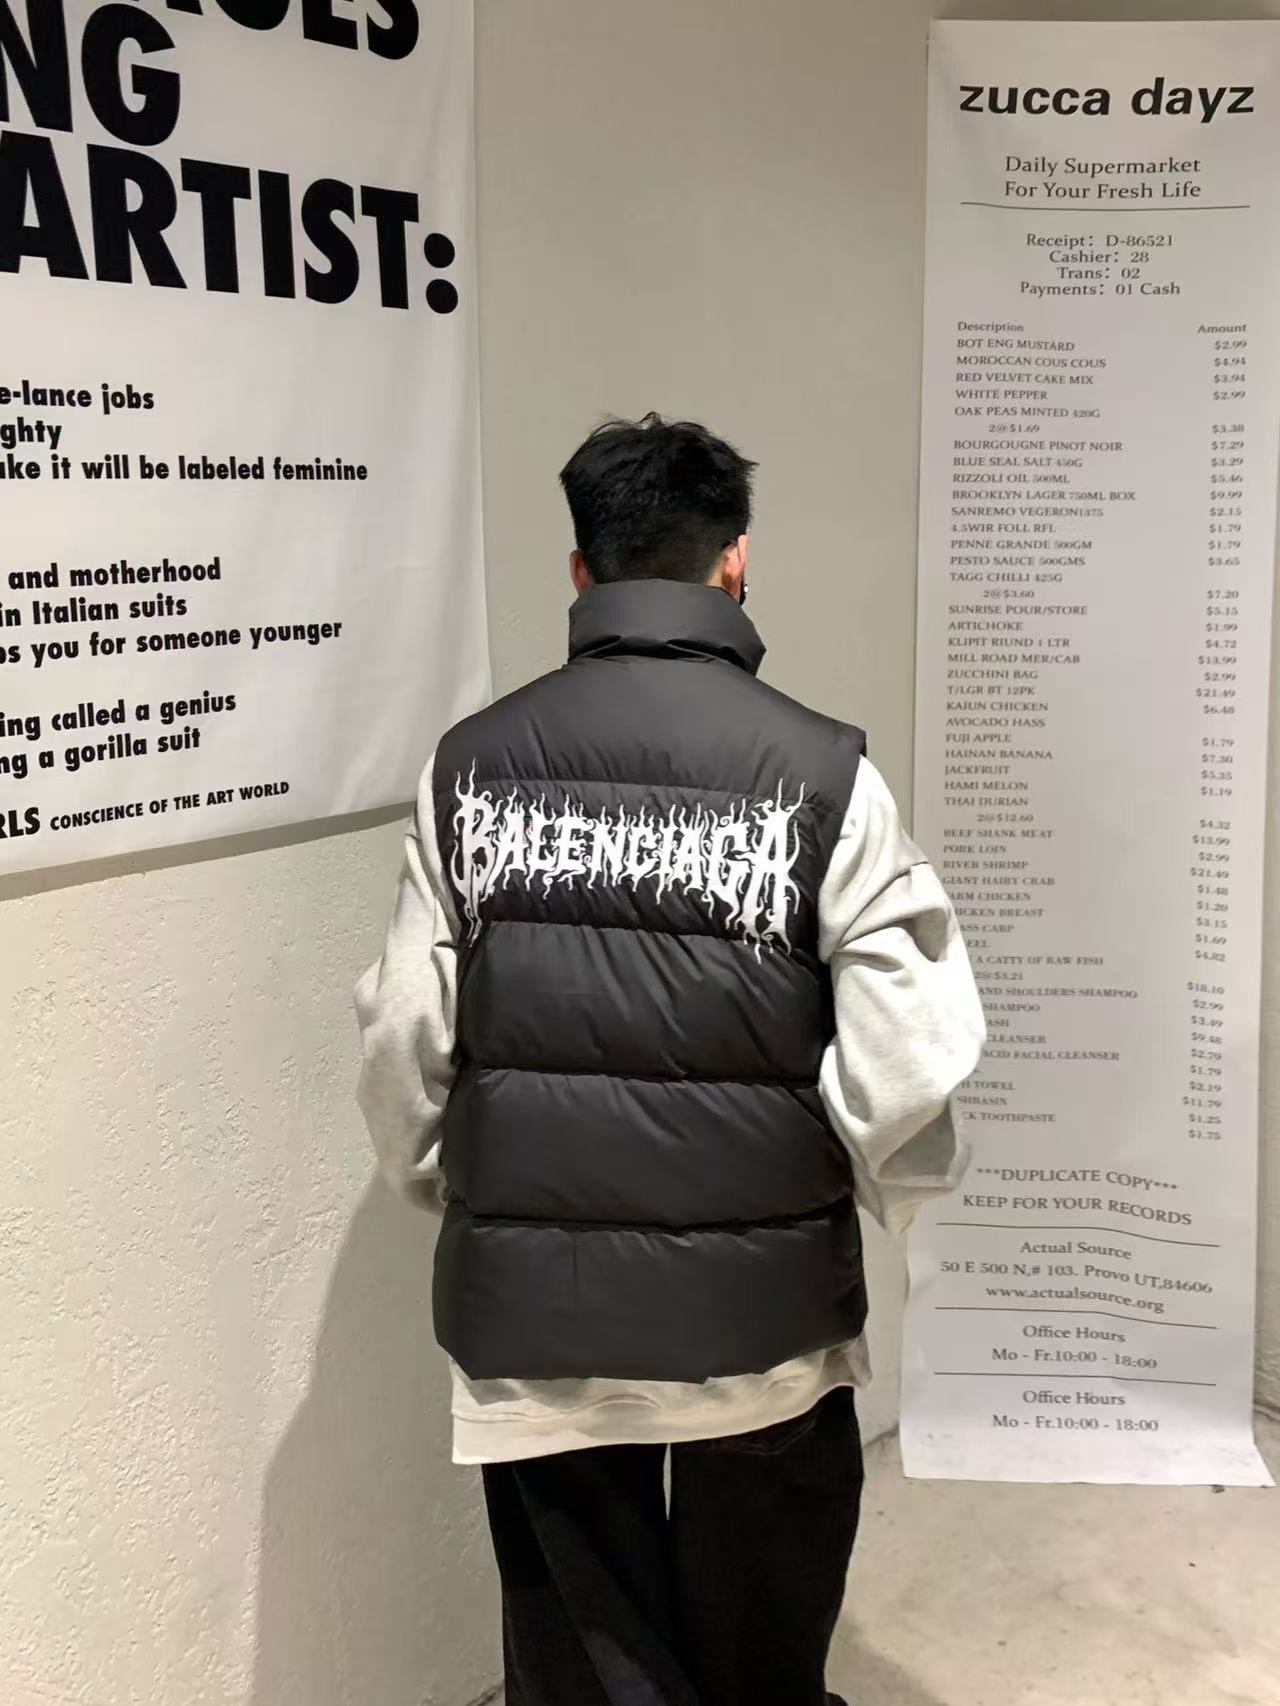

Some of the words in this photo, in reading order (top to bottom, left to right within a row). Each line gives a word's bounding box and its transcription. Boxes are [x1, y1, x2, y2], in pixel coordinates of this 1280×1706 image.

[960, 85, 1111, 116] zucca
[1132, 77, 1255, 123] dayz
[1005, 156, 1057, 177] Daily
[1065, 157, 1201, 178] Supermarket
[1005, 181, 1037, 198] For
[1044, 182, 1090, 199] Your
[1097, 183, 1152, 199] Fresh
[1162, 182, 1201, 198] Life
[0, 130, 458, 314] ARTIST:
[1106, 235, 1173, 247] D-86521
[1130, 252, 1149, 263] 28
[1121, 268, 1140, 279] 02
[1116, 284, 1132, 295] 01
[1140, 283, 1180, 295] Cash
[958, 322, 1024, 333] Description
[1197, 325, 1246, 333] Amount
[957, 339, 983, 348] BOT
[988, 339, 1013, 349] ENG
[1017, 340, 1075, 351] MUSTARD
[957, 356, 1032, 366] MOROCCAN
[1035, 357, 1067, 367] COUS
[1071, 358, 1106, 368] COUS
[956, 373, 982, 382] RED
[986, 373, 1031, 383] VELVET
[1035, 374, 1066, 384] CAKE
[1070, 375, 1094, 384] MIX
[0, 380, 92, 406] e-lance
[102, 383, 154, 414] jobs
[956, 390, 999, 399] WHITE
[1004, 390, 1047, 399] PEPPER
[955, 407, 982, 416] OAK
[987, 407, 1017, 416] PEAS
[1021, 408, 1068, 417] MINTED
[0, 418, 61, 449] ghty
[1049, 442, 1086, 450] PINOT
[1089, 442, 1122, 451] NOIR
[52, 454, 71, 479] it
[82, 455, 129, 479] will
[140, 456, 169, 479] be
[179, 456, 264, 479] labeled
[273, 458, 368, 480] feminine
[953, 457, 985, 466] BLUE
[989, 458, 1020, 466] SEAL
[1024, 458, 1052, 466] SALT
[953, 474, 1002, 483] RIZZOLI
[1007, 474, 1029, 483] OIL
[952, 490, 1022, 499] BROOKLYN
[1026, 491, 1066, 500] LAGER
[1109, 492, 1136, 500] BOX
[952, 508, 1016, 516] SANREMO
[951, 540, 993, 549] PENNE
[997, 540, 1050, 549] GRANDE
[950, 556, 990, 565] PESTO
[993, 557, 1034, 566] SAUCE
[8, 563, 58, 589] and
[70, 557, 221, 586] motherhood
[950, 573, 983, 581] TAGG
[987, 573, 1030, 582] CHILLI
[32, 598, 119, 624] Italian
[130, 593, 187, 618] suits
[948, 606, 1001, 614] SUNRISE
[1006, 606, 1087, 615] POUR/STORE
[948, 622, 1024, 631] ARTICHOKE
[32, 639, 79, 668] you
[90, 632, 126, 656] for
[137, 626, 241, 652] someone
[250, 621, 342, 649] younger
[948, 654, 977, 663] MILL
[982, 654, 1017, 663] ROAD
[1021, 654, 1080, 664] MER/CAB
[947, 670, 1009, 679] ZUCCHINI
[1013, 670, 1038, 679] BAG
[990, 702, 1048, 711] CHICKEN
[0, 712, 40, 740] ing
[52, 700, 125, 730] called
[136, 704, 149, 720] a
[160, 691, 236, 724] genius
[946, 718, 1008, 727] AVOCADO
[1012, 719, 1046, 727] HASS
[946, 734, 970, 743] FUJI
[974, 734, 1011, 743] APPLE
[39, 751, 54, 768] a
[65, 733, 147, 771] gorilla
[158, 726, 200, 752] suit
[945, 750, 996, 758] HAINAN
[1000, 750, 1053, 759] BANANA
[945, 766, 1010, 775] JACKFRUIT
[945, 781, 978, 790] HAMI
[983, 782, 1028, 790] MELON
[50, 803, 143, 830] CONSCIENCE
[150, 799, 168, 814] OF
[174, 794, 200, 810] THE
[207, 790, 234, 806] ART
[239, 782, 289, 800] WORLD
[944, 797, 975, 806] THAI
[979, 797, 1028, 806] DURIAN
[943, 845, 975, 853] PORK
[450, 758, 807, 964] BALENCIAGA
[964, 1195, 1008, 1208] KEEP
[1013, 1197, 1048, 1209] FOR
[1053, 1198, 1102, 1210] YOUR
[1108, 1200, 1192, 1225] RECORDS
[1020, 1242, 1072, 1254] Actual
[1078, 1242, 1132, 1260] Source
[940, 1262, 960, 1272] 50
[965, 1262, 975, 1272] E
[980, 1263, 1008, 1274] 500
[1084, 1265, 1130, 1282] Provo
[986, 1287, 1164, 1314] www.actualsource.org
[1023, 1326, 1071, 1338] Office
[1076, 1327, 1126, 1343] Hours
[992, 1349, 1018, 1361] Mo
[1114, 1354, 1157, 1368] 18:00
[1023, 1391, 1071, 1404] Office
[1076, 1392, 1126, 1405] Hours
[993, 1415, 1019, 1427] Mo
[1116, 1418, 1159, 1431] 18:00
